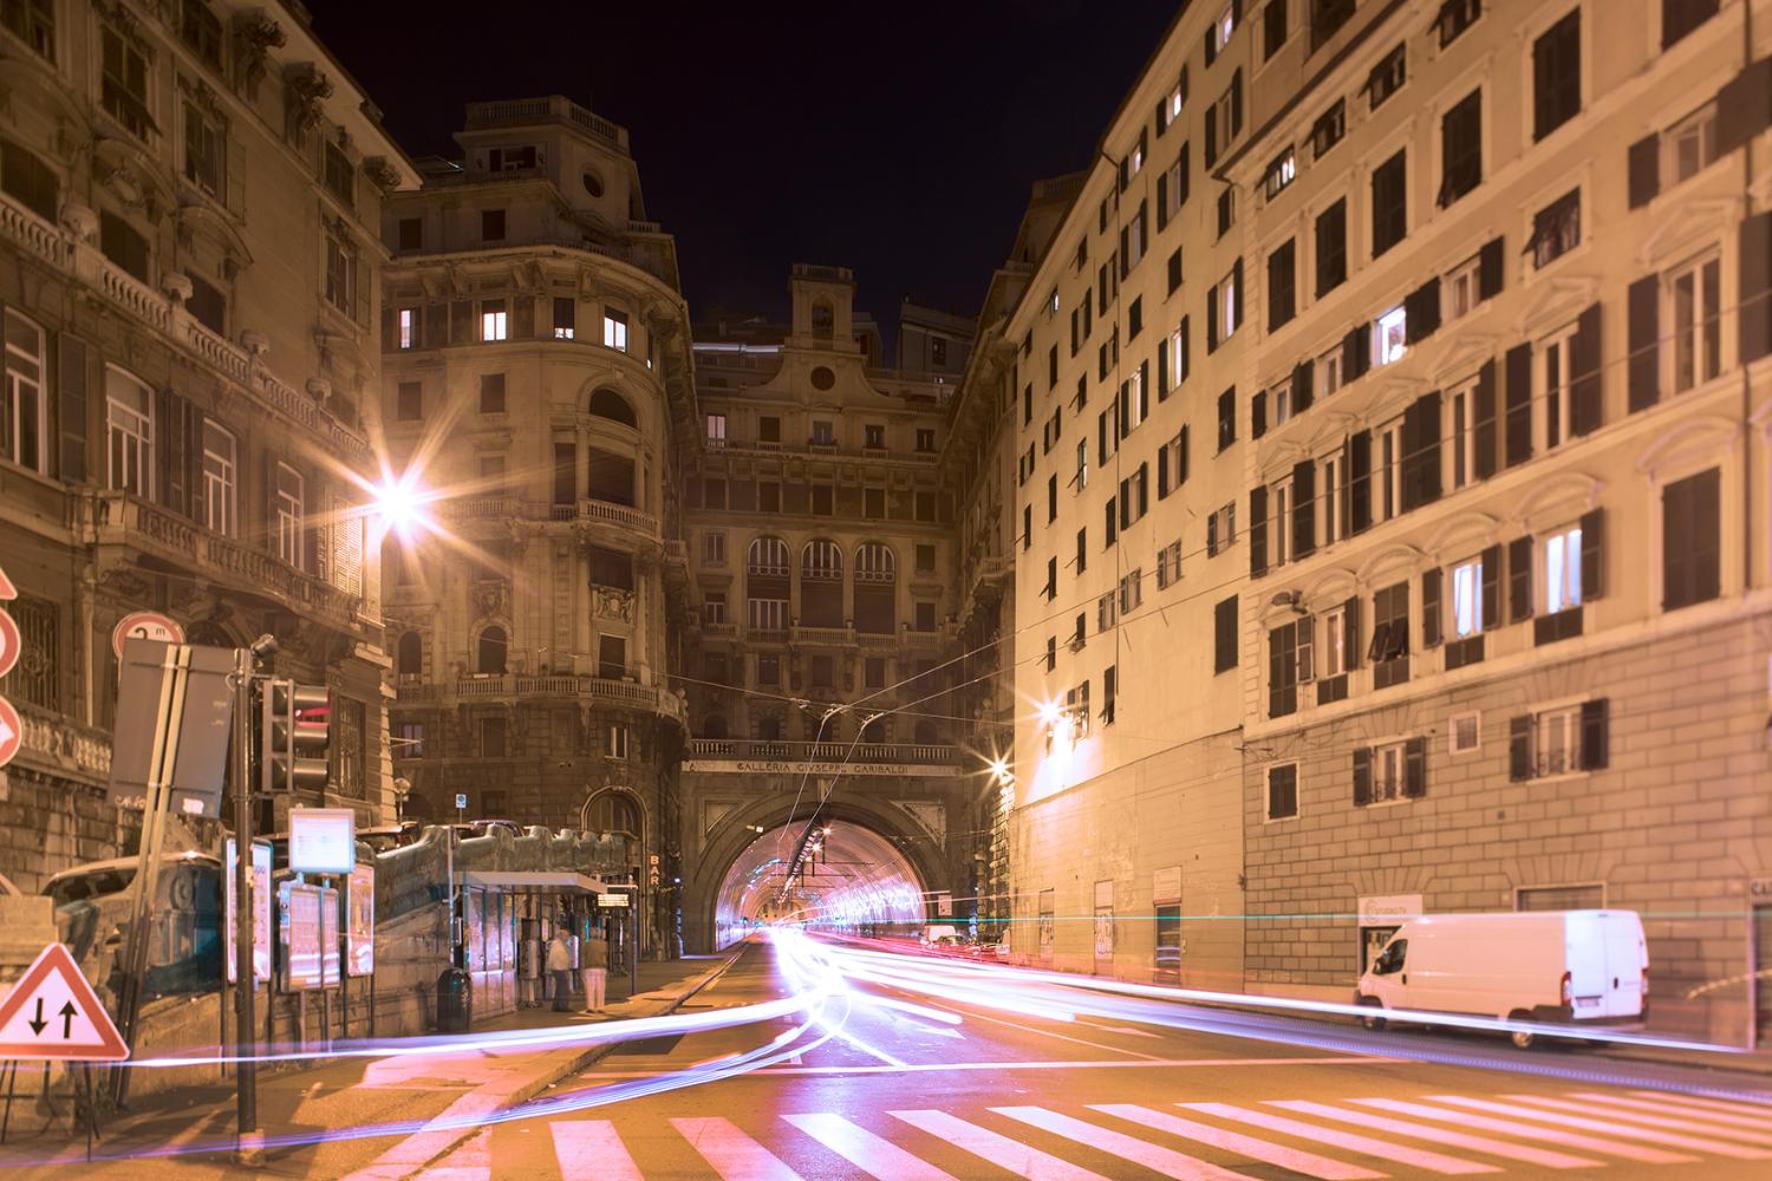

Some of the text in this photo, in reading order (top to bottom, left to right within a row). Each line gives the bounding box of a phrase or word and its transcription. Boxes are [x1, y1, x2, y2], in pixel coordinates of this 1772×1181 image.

[737, 763, 790, 772] GALLERIA
[854, 764, 909, 774] GARIBALDI
[650, 855, 660, 885] BAR
